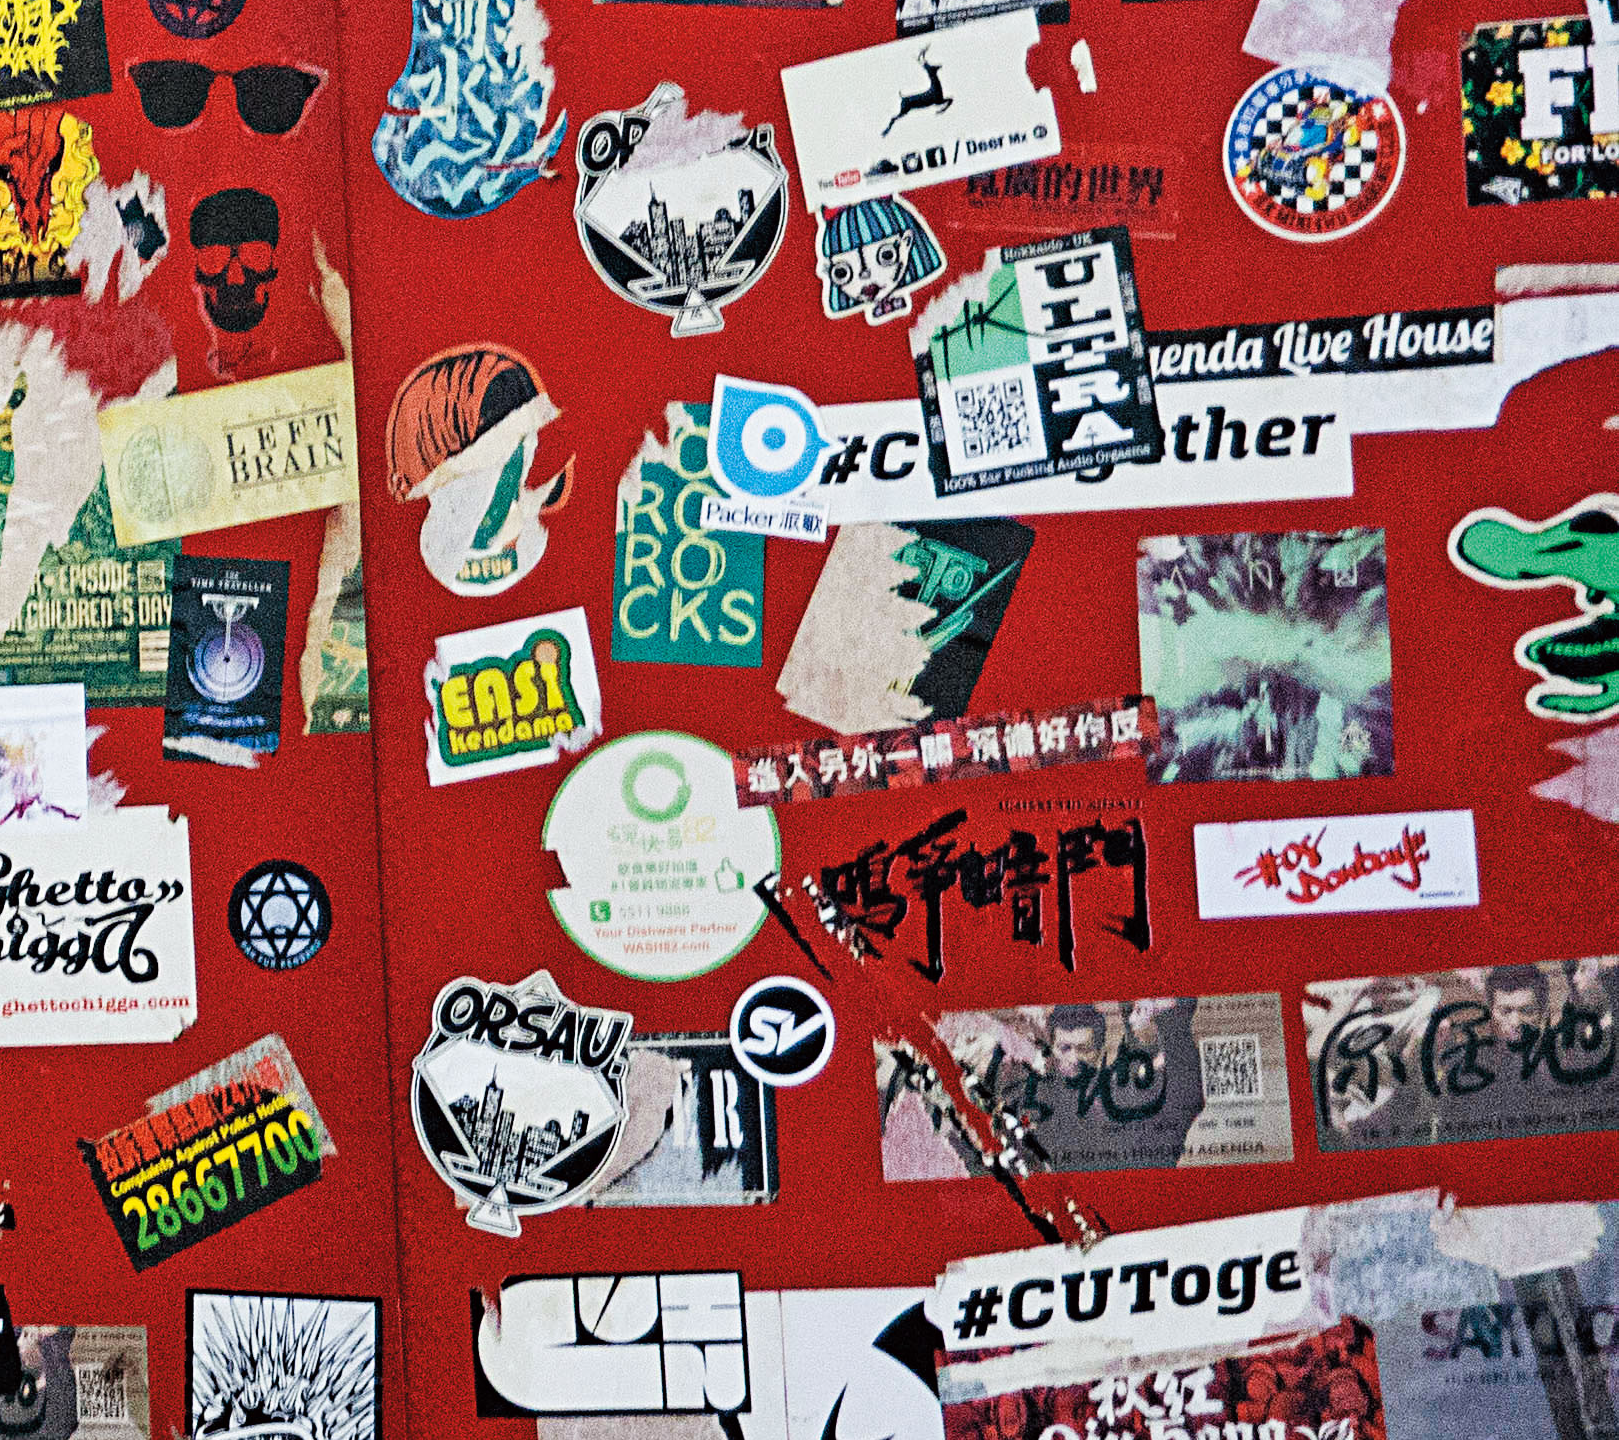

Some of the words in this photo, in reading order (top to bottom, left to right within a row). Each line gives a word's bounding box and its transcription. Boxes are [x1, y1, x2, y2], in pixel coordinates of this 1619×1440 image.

[225, 414, 341, 462] LEFT
[228, 438, 346, 487] BRAIN
[703, 501, 779, 532] Packer
[620, 588, 757, 650] CKS
[448, 707, 575, 756] kendama
[436, 983, 628, 1076] ORSAU.
[119, 1107, 324, 1254] 28667700
